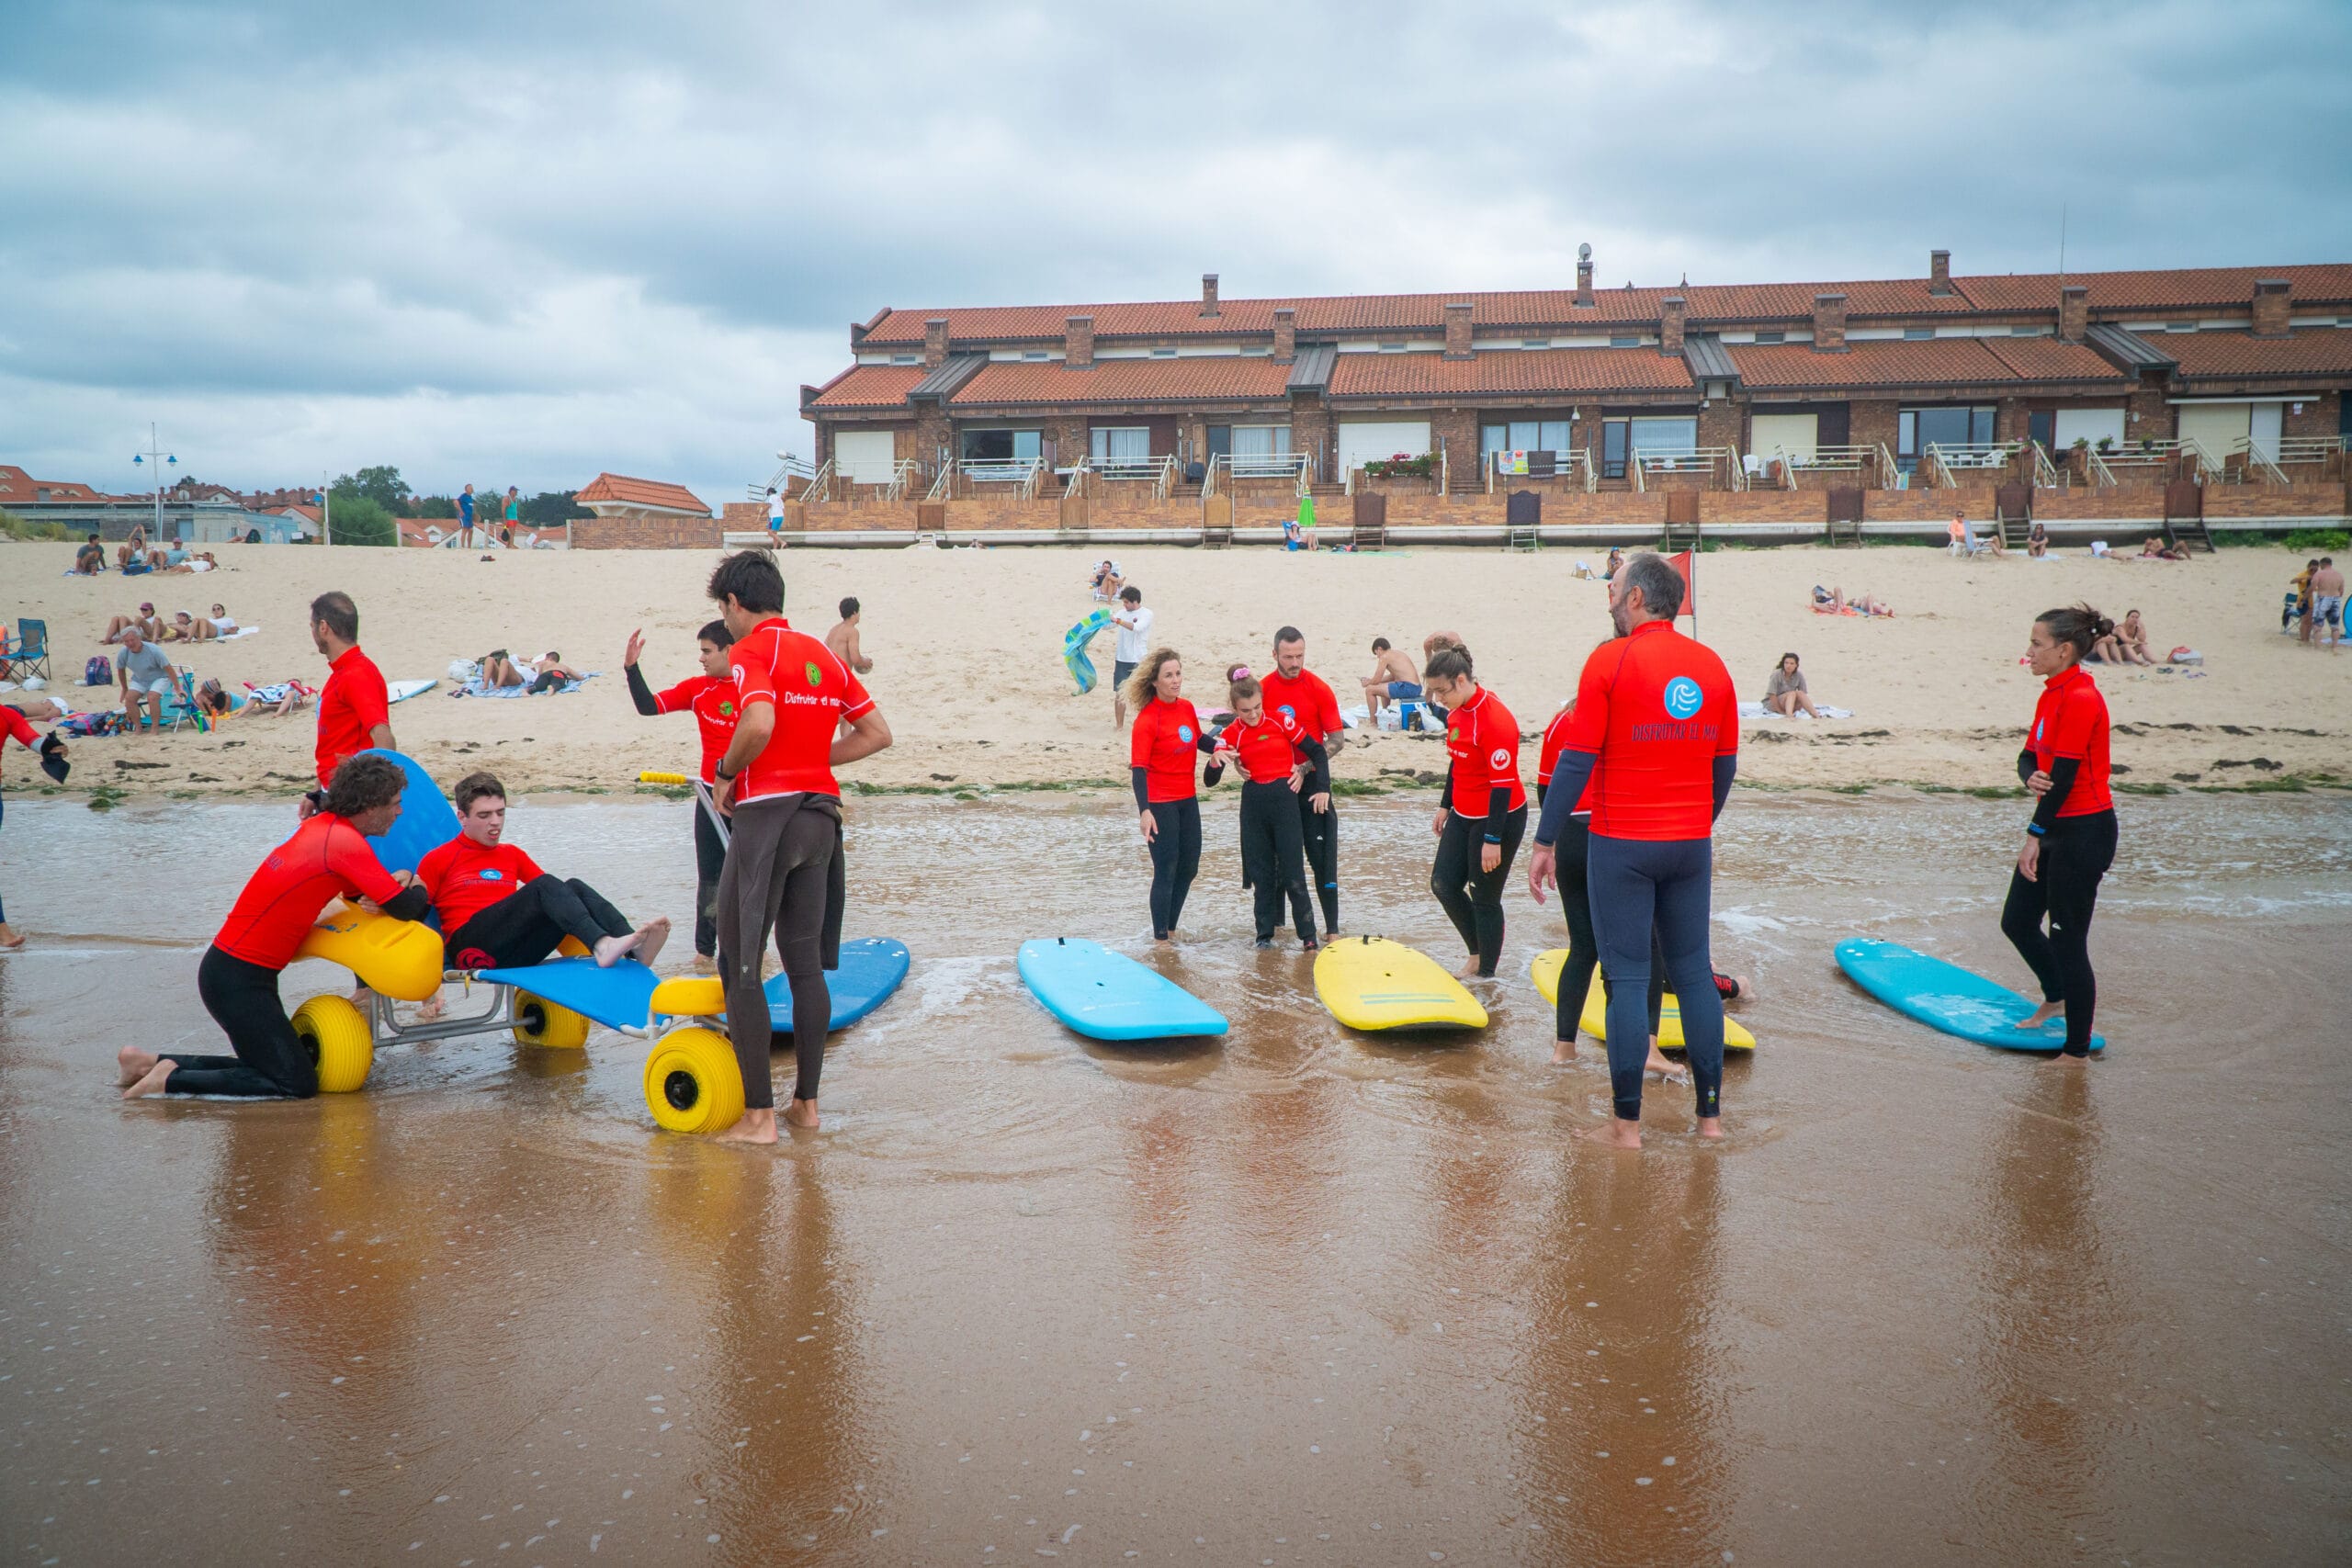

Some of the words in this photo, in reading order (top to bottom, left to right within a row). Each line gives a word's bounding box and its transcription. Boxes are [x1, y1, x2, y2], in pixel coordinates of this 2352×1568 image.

[785, 691, 818, 705] Disfrutar
[1632, 722, 1687, 741] DISFRUTAR
[1690, 722, 1700, 740] EL
